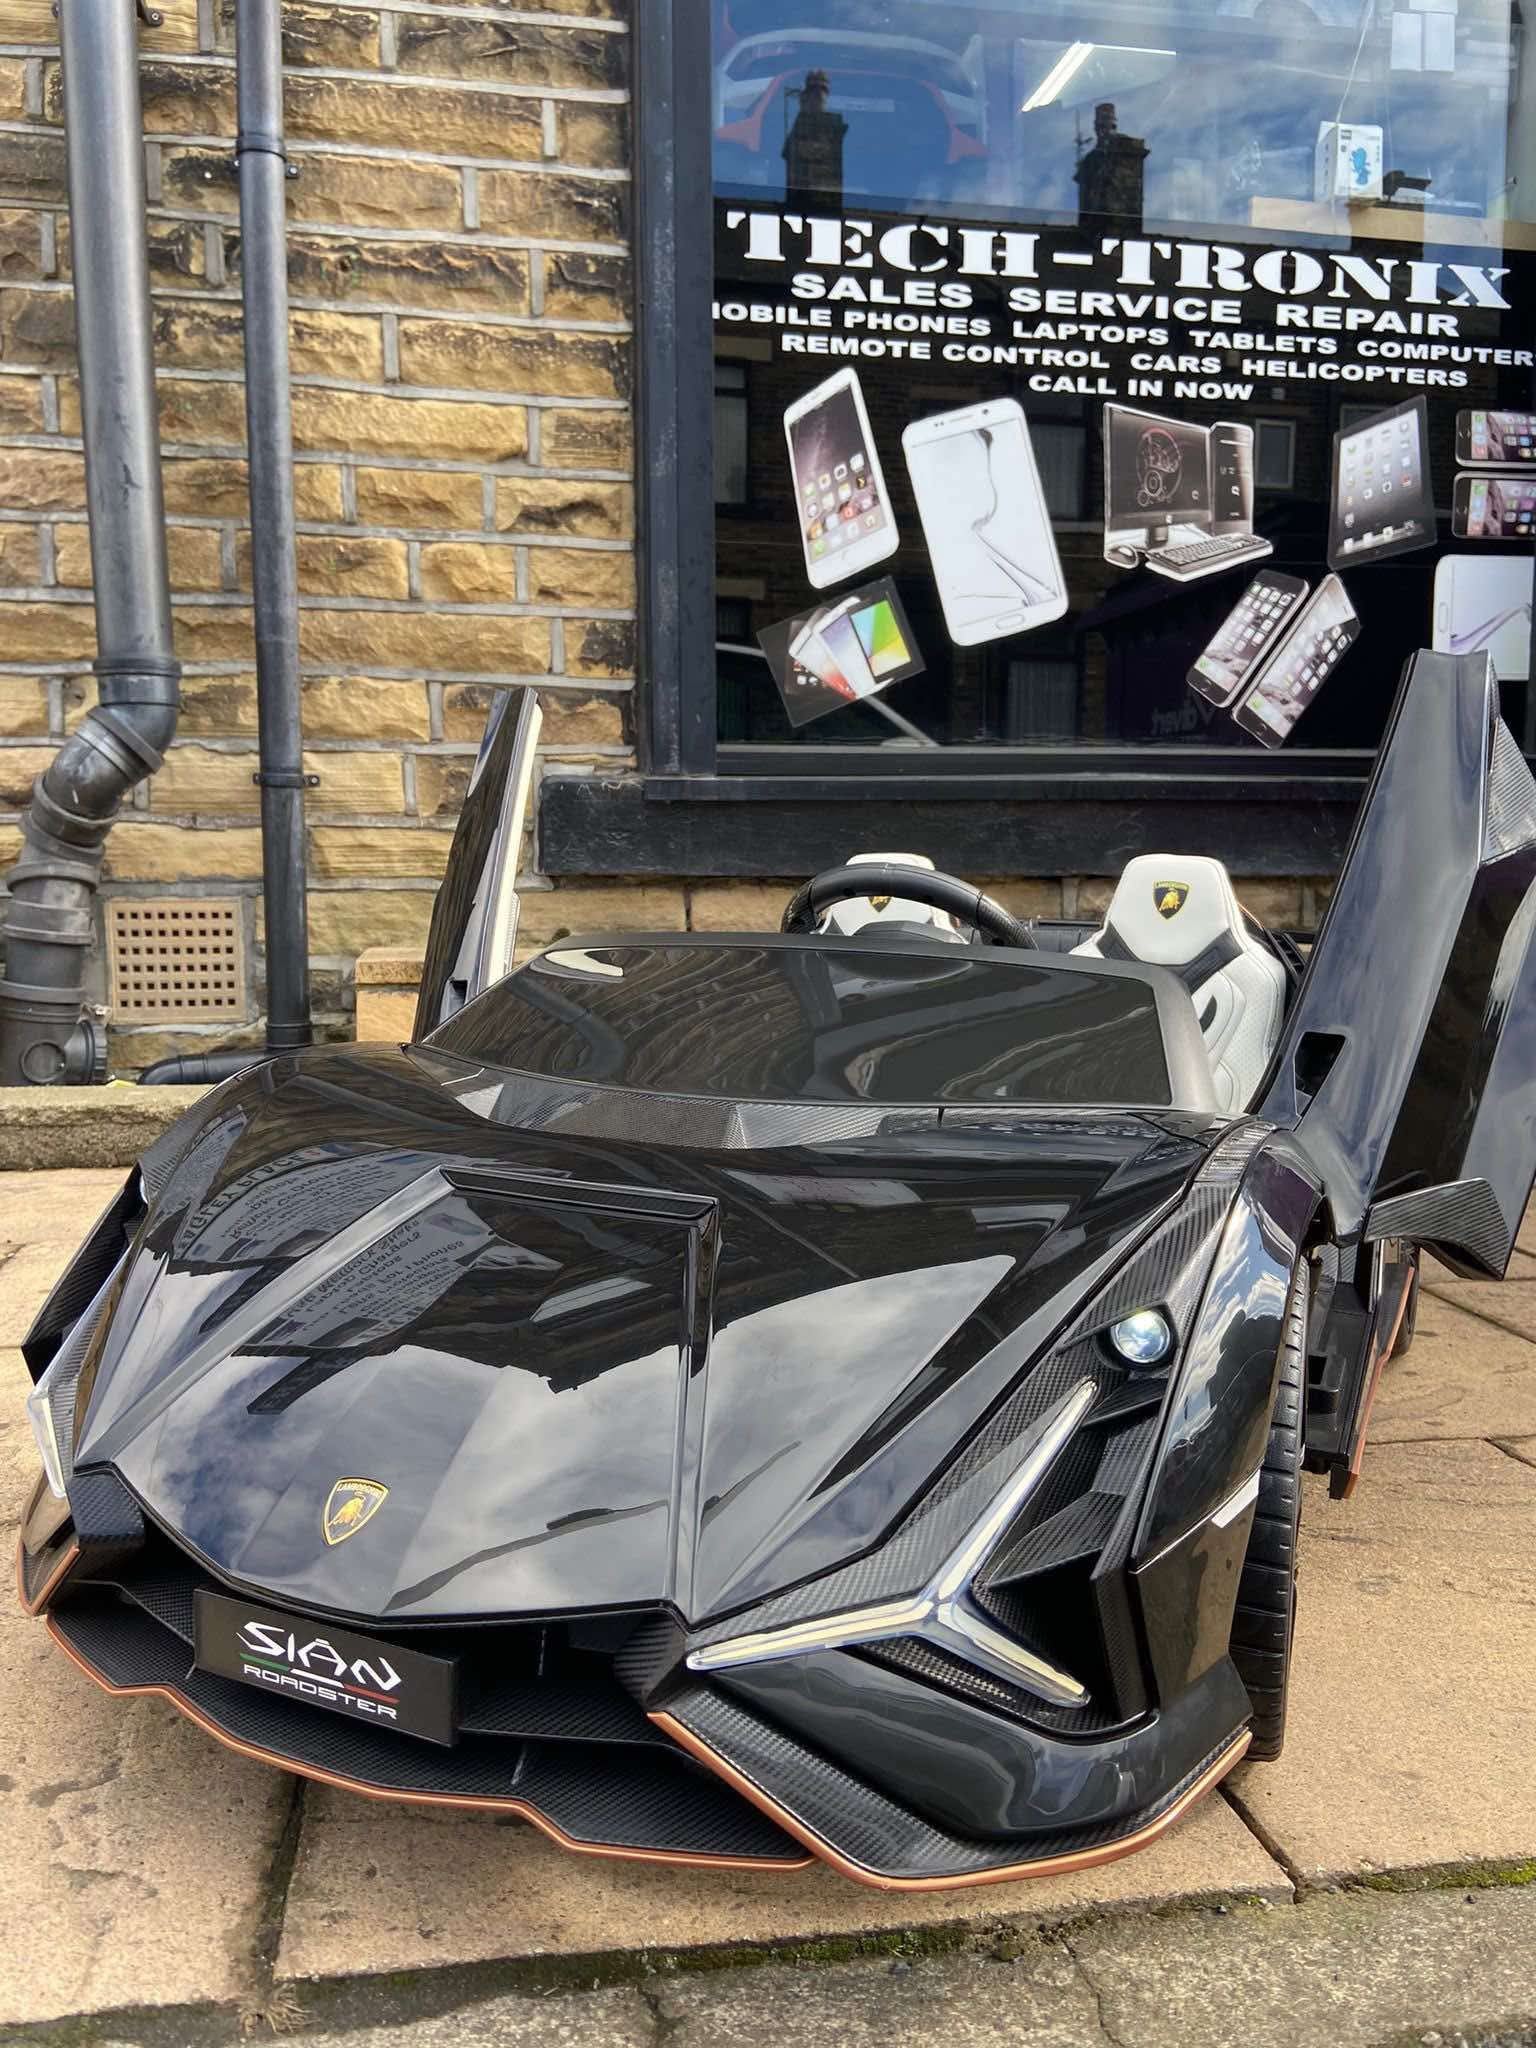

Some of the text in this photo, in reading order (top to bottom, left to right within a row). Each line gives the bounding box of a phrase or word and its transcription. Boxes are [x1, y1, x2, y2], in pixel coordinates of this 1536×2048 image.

[726, 211, 1512, 310] TECH-TRONIX
[791, 273, 1460, 337] SALES SERVICE REPAIR
[781, 334, 1468, 387] REMOTE CONTROL CARS HELICOPTERS
[844, 310, 992, 337] PHONES
[1013, 320, 1169, 346] LAPTOPS
[1188, 330, 1337, 355] TABLETS
[1357, 340, 1536, 366] COMPUTER
[1028, 374, 1254, 401] CALL IN NOW
[243, 1664, 397, 1719] ROADSTER
